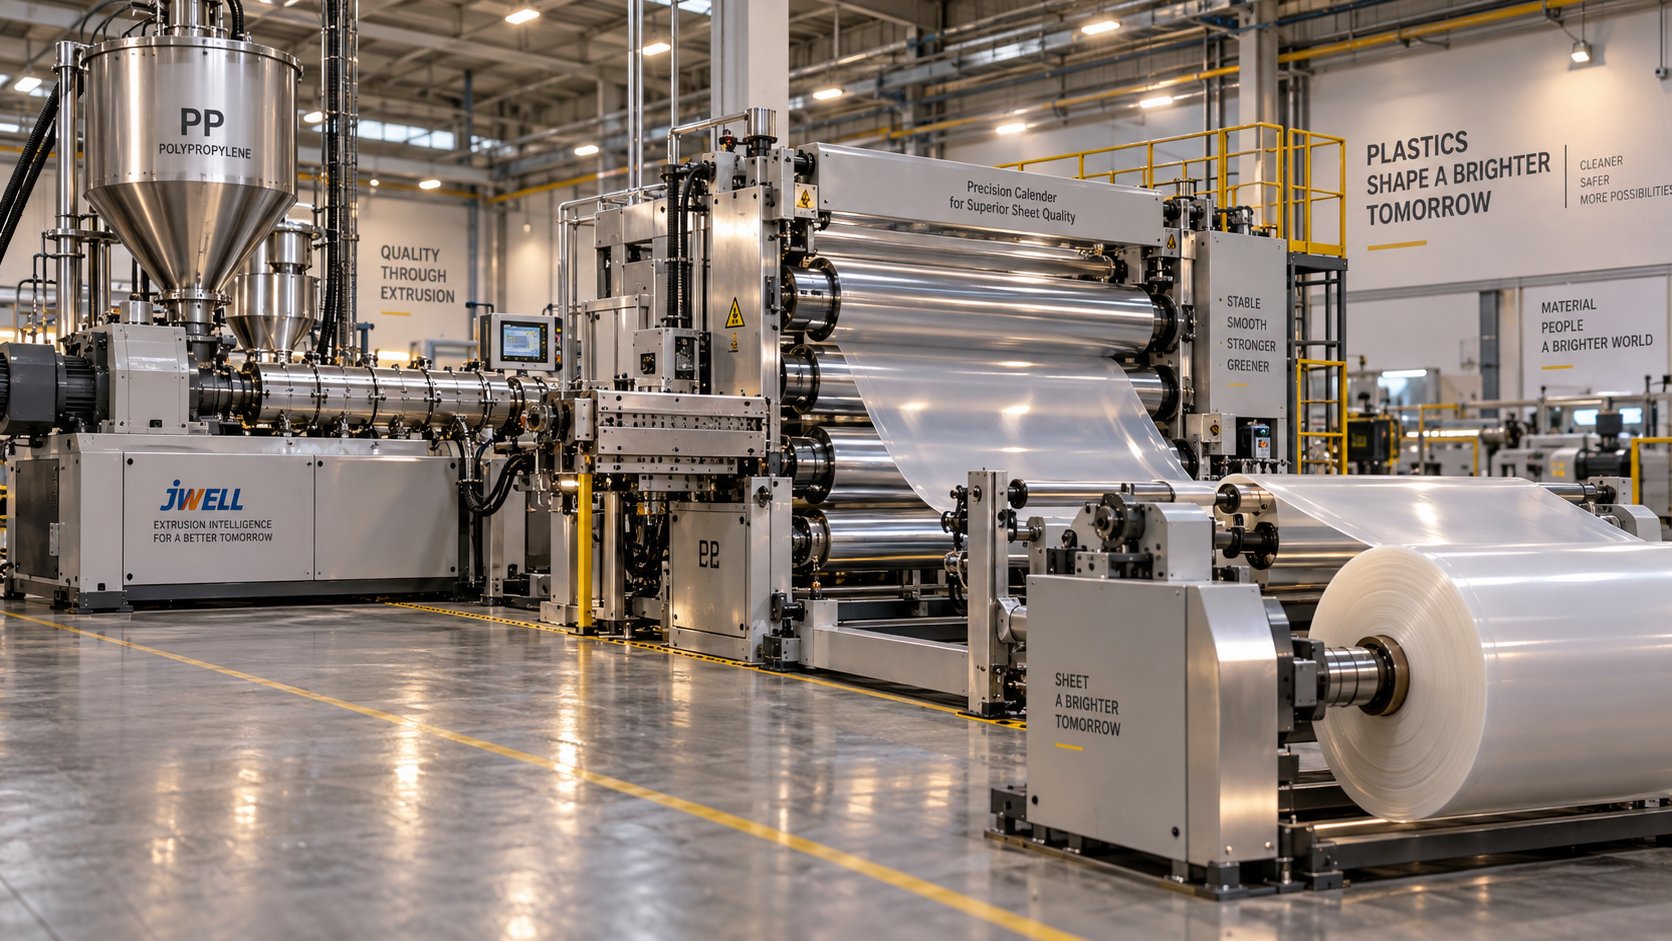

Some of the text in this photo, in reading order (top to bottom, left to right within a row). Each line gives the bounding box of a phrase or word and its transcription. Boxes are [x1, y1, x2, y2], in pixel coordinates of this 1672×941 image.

[181, 108, 224, 136] PP
[159, 143, 251, 159] POLYPROPYLENE
[1367, 130, 1468, 166] PLASTICS
[1580, 155, 1623, 170] CLEANER
[1367, 151, 1551, 195] SHAPE A BRIGHTER
[1580, 174, 1610, 188] SAFER
[967, 180, 1057, 203] Precision Calender
[1580, 192, 1608, 205] MORE
[949, 196, 1076, 226] for Superior Sheet Quality
[1366, 190, 1491, 225] TOMORROW
[381, 245, 440, 262] QUALITY
[381, 265, 447, 283] THROUGH
[381, 286, 455, 303] EXTRUSION
[1227, 295, 1261, 310] STABLE
[1541, 298, 1597, 314] MATERIAL
[1227, 316, 1267, 331] SMOOTH
[1541, 319, 1584, 334] PEOPLE
[1227, 337, 1276, 352] STRONGER
[1541, 334, 1654, 353] A BRIGHTER WORLD
[1227, 358, 1270, 373] GREENER
[153, 520, 272, 529] EXTRUSION INTELLIGENCE
[153, 532, 273, 543] FOR A BETTER TOMORROW
[1055, 672, 1089, 690] SHEET
[1055, 693, 1119, 715] A BRIGHTER
[1055, 714, 1121, 737] TOMORROW
